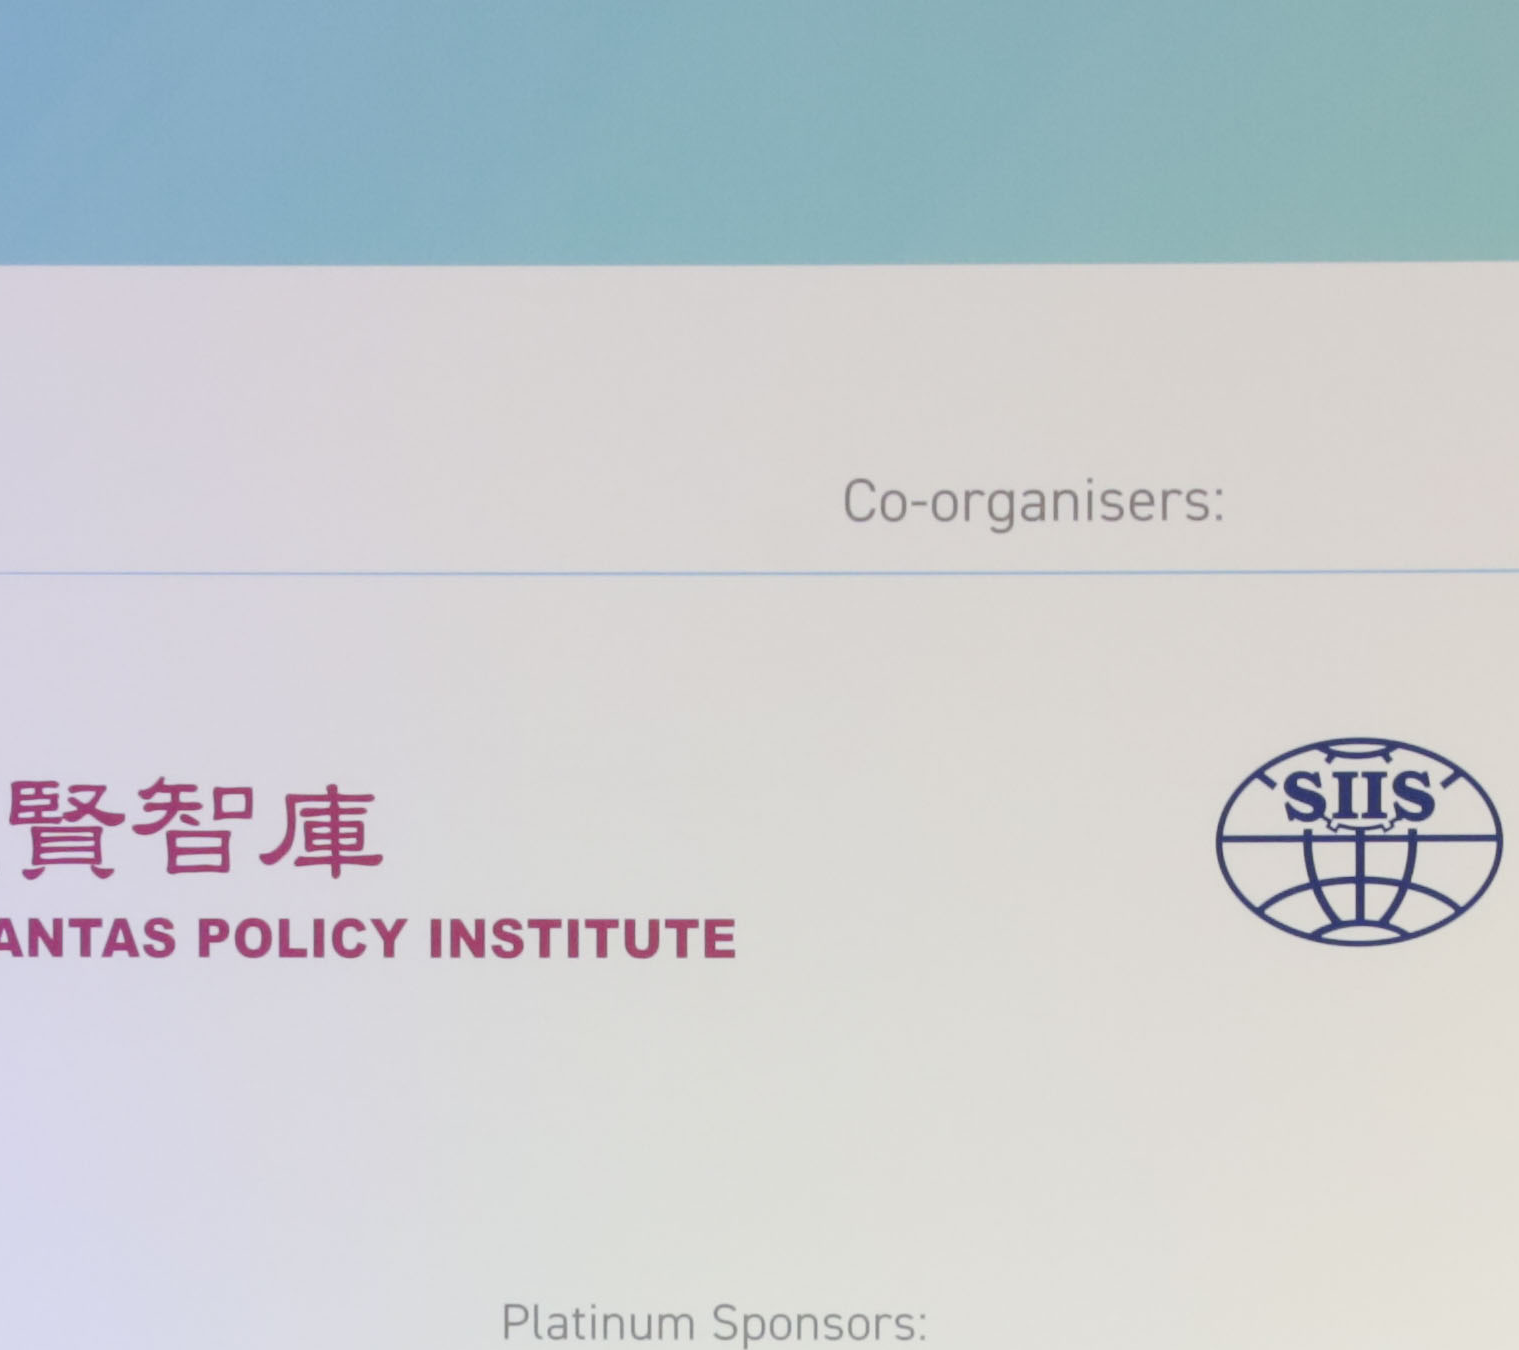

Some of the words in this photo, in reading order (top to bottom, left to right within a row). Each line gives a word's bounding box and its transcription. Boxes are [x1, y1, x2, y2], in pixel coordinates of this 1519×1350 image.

[845, 478, 1222, 534] Co-organisers:
[1283, 771, 1435, 823] SIIS
[199, 918, 407, 958] POLICY
[431, 918, 735, 959] INSTITUTE
[504, 1303, 694, 1340] Platinum
[713, 1303, 925, 1350] Sponsors:
